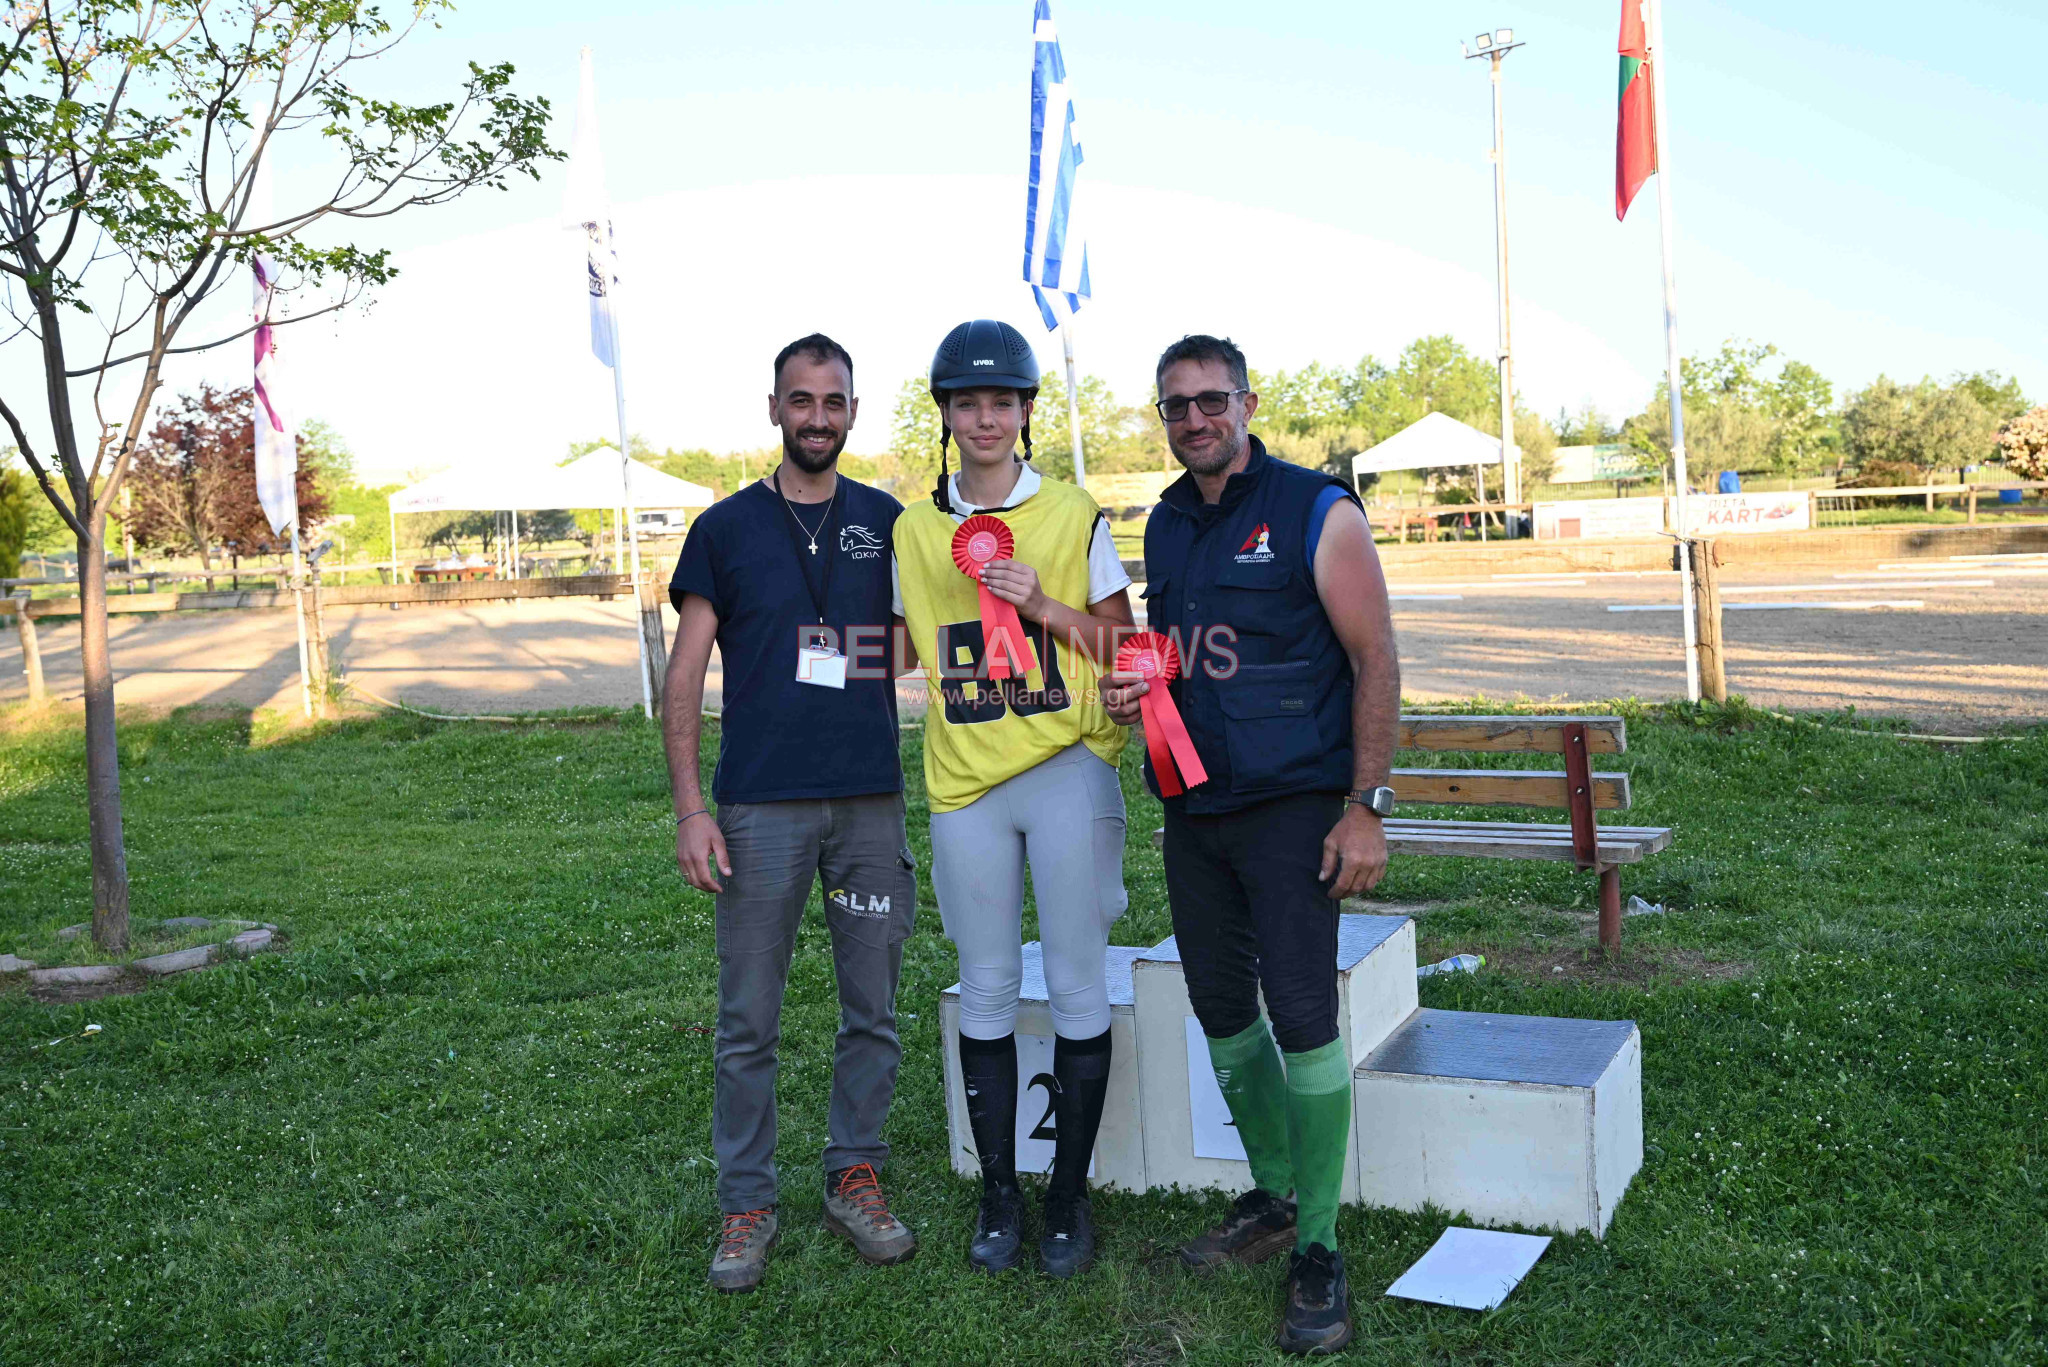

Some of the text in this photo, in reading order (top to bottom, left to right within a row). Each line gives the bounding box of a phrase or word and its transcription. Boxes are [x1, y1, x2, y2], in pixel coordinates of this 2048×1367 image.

[1707, 507, 1765, 525] KART
[937, 612, 1073, 725] 80
[1027, 1072, 1059, 1141] 2
